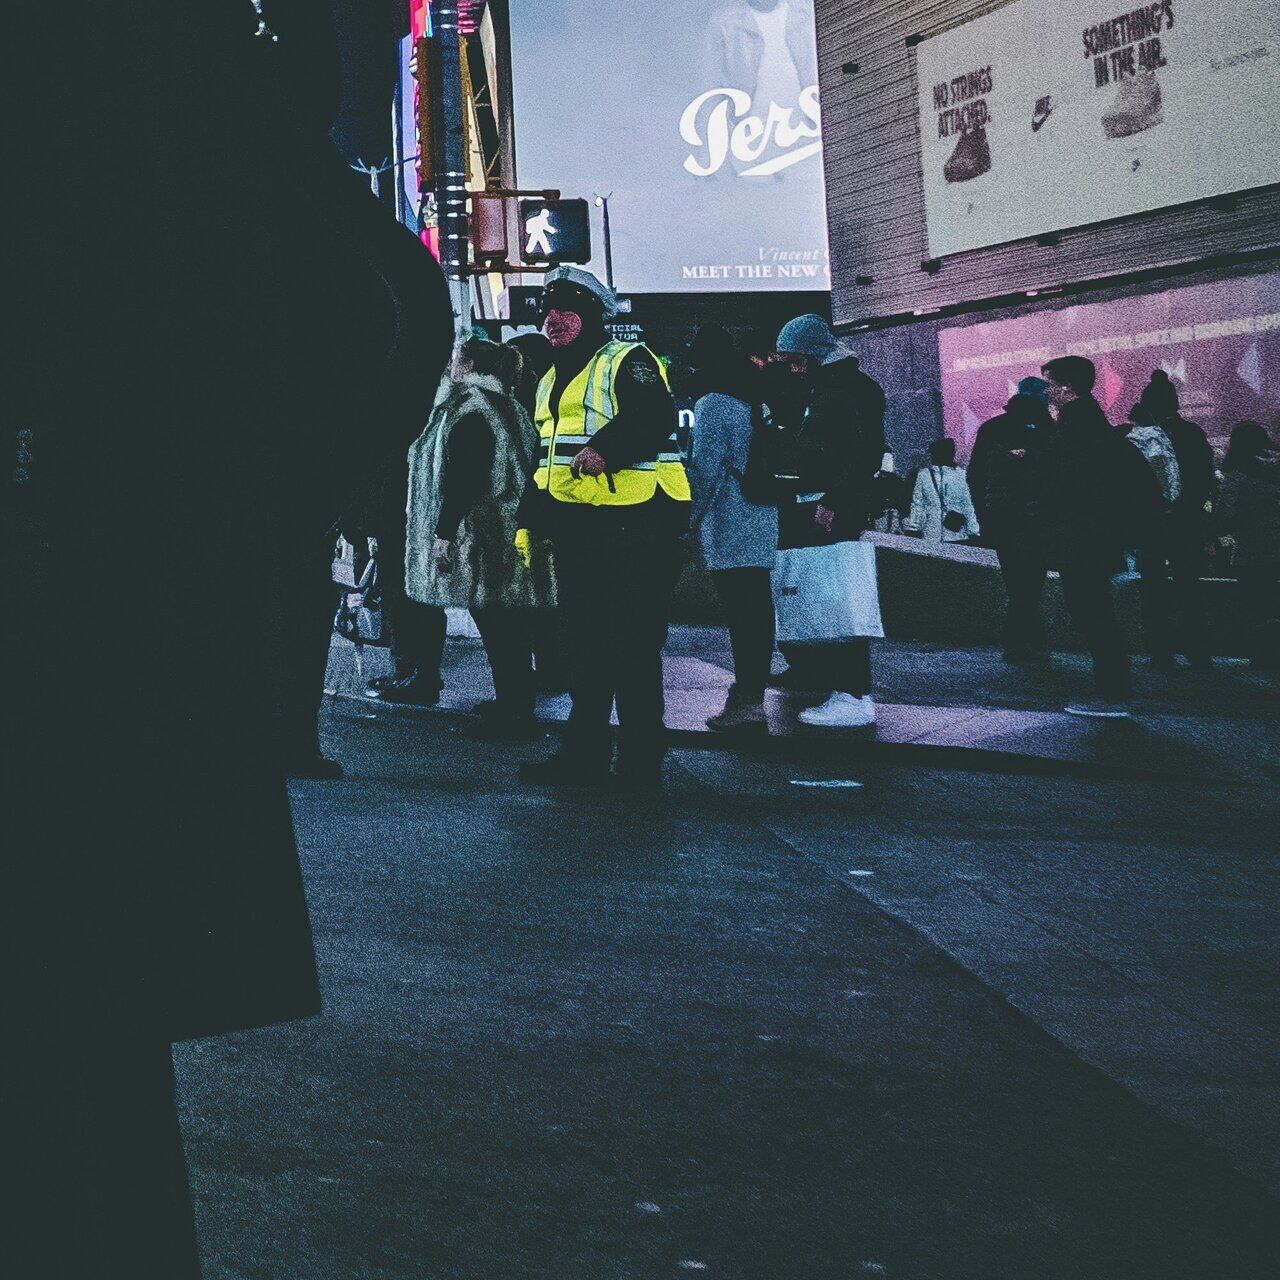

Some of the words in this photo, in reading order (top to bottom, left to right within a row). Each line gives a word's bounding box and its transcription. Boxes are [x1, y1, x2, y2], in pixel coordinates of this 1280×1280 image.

[682, 265, 730, 279] MEET
[735, 265, 772, 278] THE
[777, 265, 820, 278] NEW
